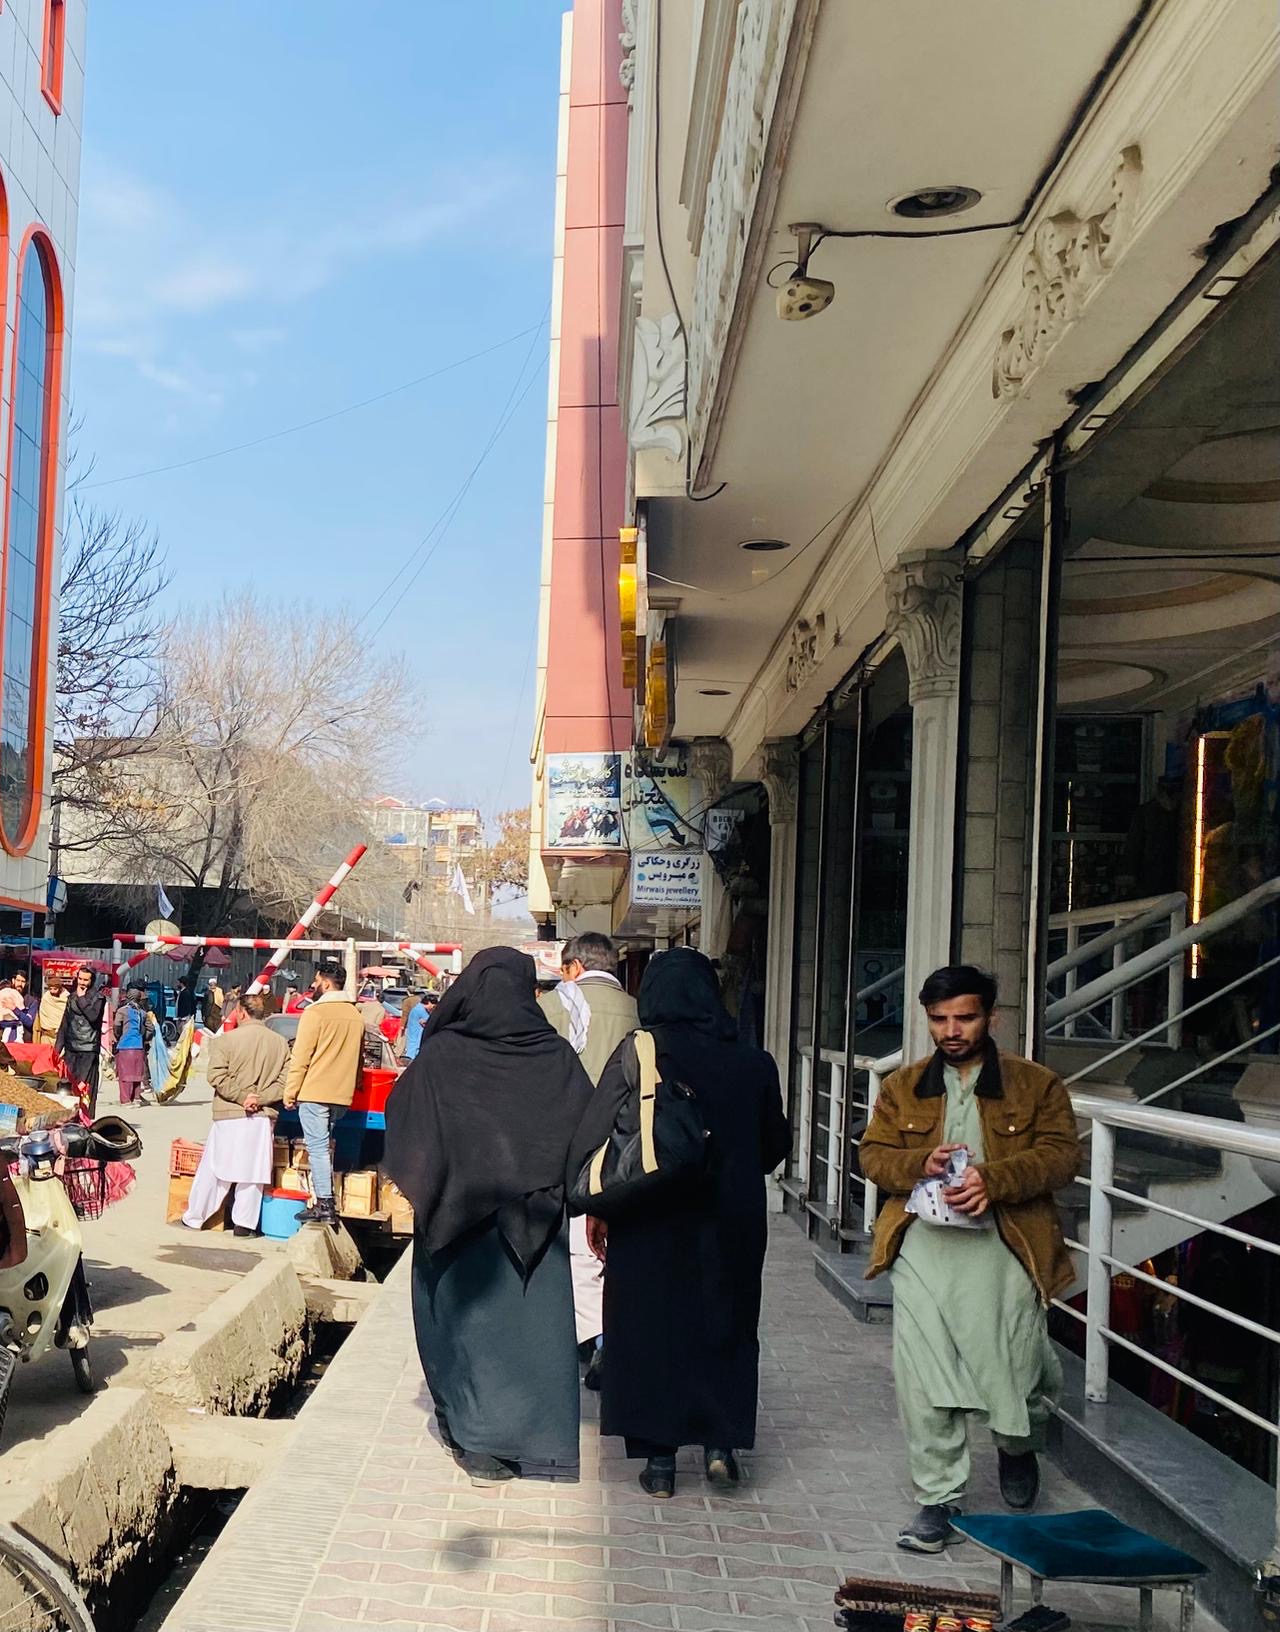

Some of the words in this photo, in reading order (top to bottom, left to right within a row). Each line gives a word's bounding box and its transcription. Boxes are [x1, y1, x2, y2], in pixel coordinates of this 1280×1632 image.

[637, 856, 666, 868] حکاکی
[672, 856, 700, 870] زرگری
[648, 872, 686, 882] میرویس
[636, 885, 665, 894] Mirwais
[665, 886, 699, 897] jewellery
